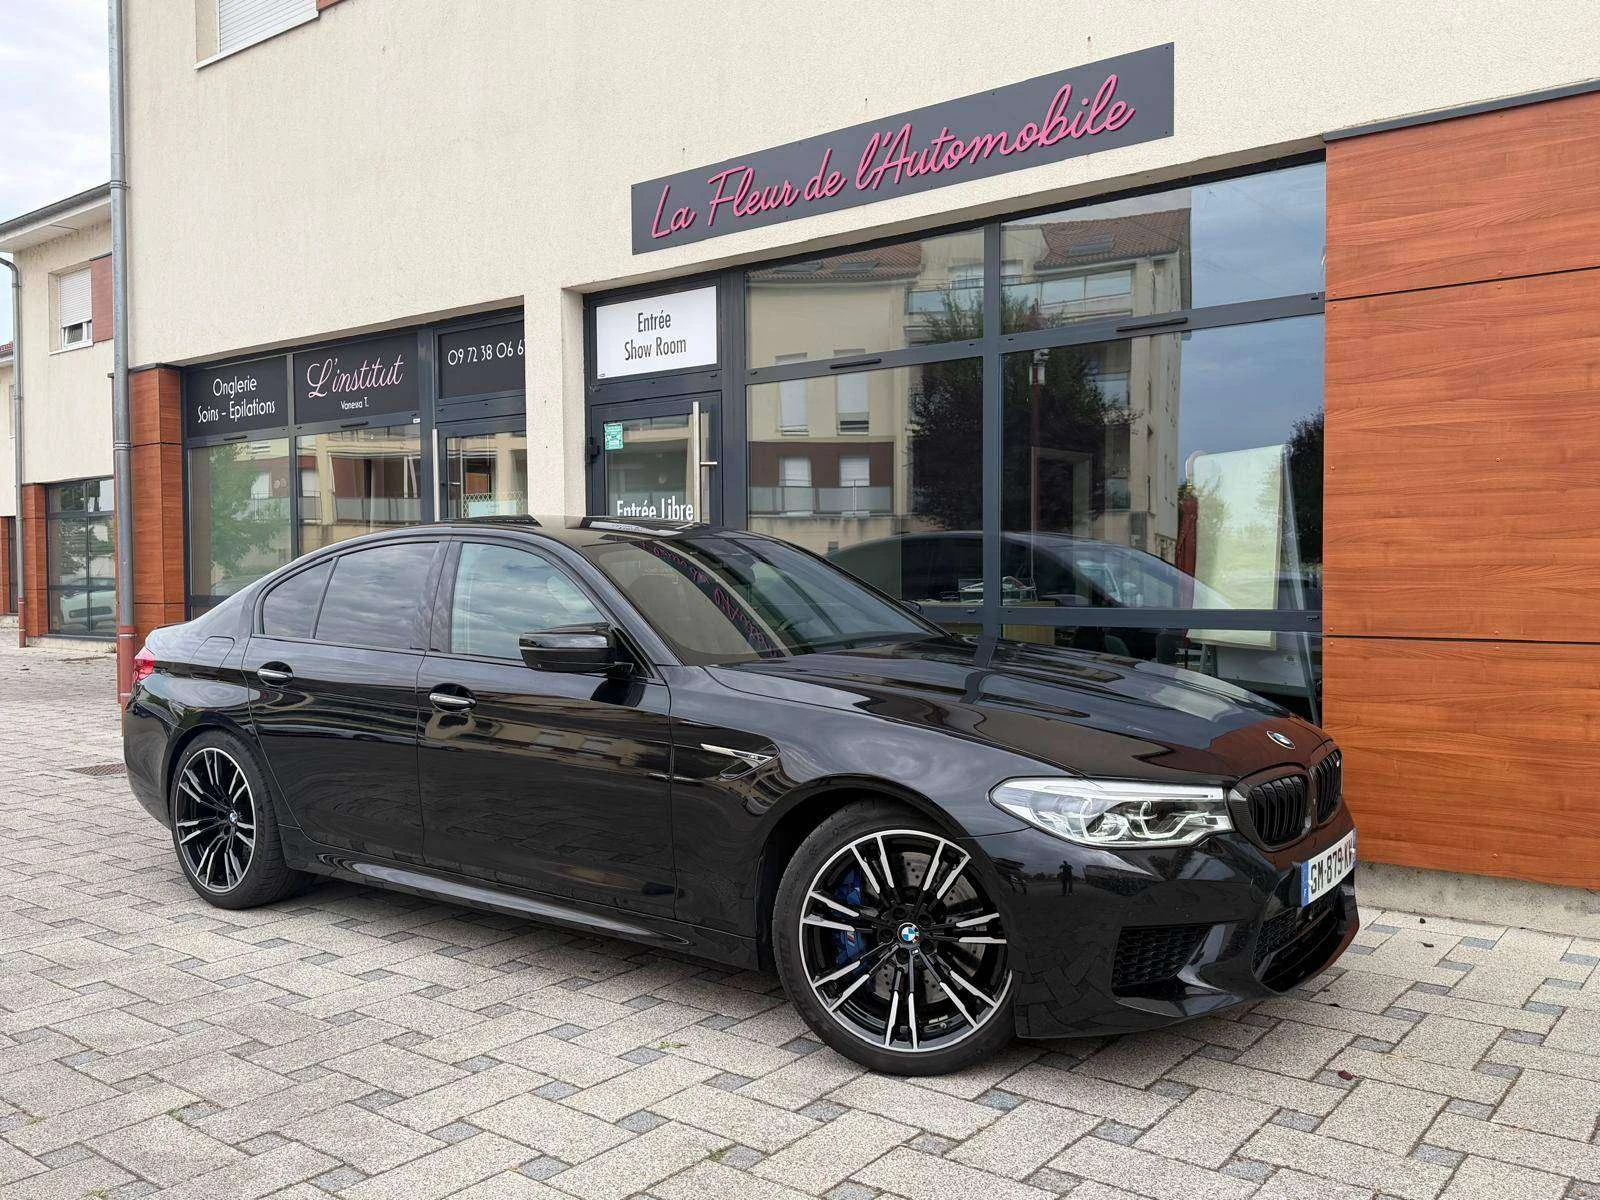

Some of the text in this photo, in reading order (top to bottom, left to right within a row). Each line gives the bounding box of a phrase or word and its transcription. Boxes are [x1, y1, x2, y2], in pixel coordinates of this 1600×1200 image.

[651, 73, 1136, 239] La Fleur de l'Automobile
[637, 309, 672, 333] Entrée
[447, 338, 526, 366] 09 72 38 06 6
[624, 336, 687, 361] Show Room
[212, 375, 257, 399] Onglerie
[306, 353, 404, 398] L'institut
[197, 405, 219, 424] Soins
[229, 398, 275, 423] Epilations
[616, 495, 694, 521] Entrée Libre
